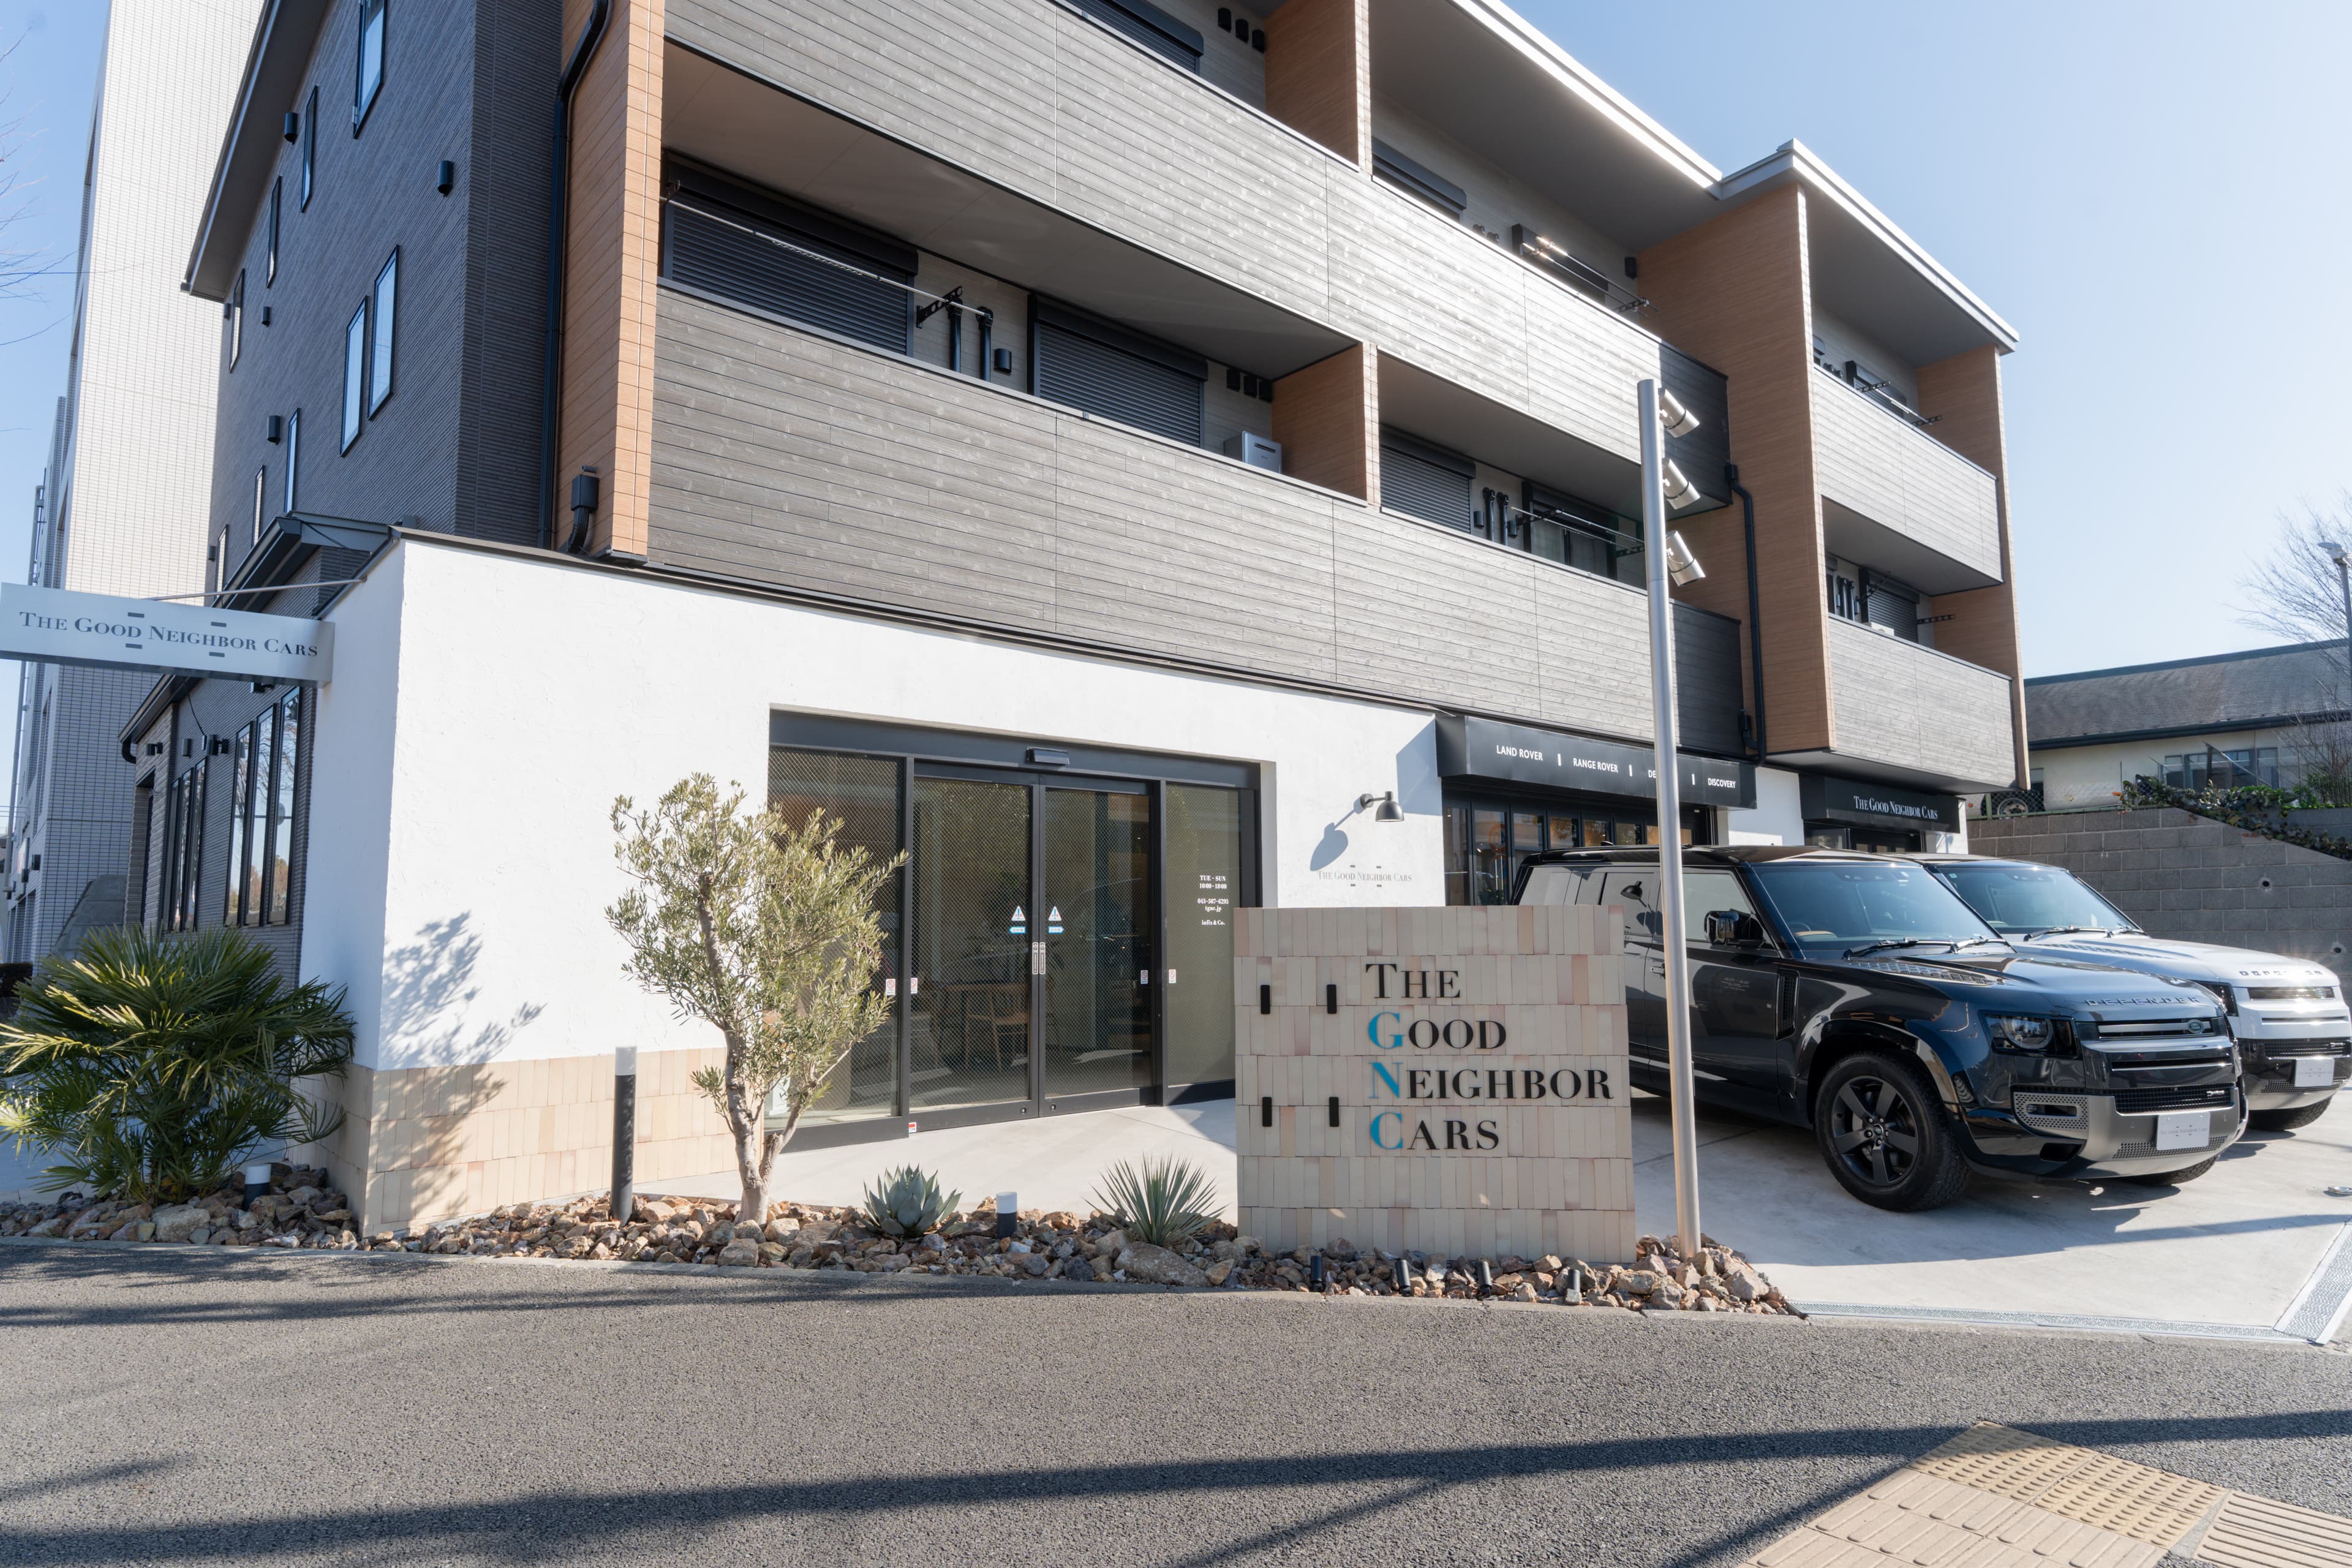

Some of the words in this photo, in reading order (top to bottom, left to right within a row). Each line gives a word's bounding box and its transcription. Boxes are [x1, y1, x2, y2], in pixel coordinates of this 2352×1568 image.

[19, 611, 67, 631] THE
[74, 617, 142, 638] GOOD
[148, 625, 256, 651] NEIGHBOR
[264, 638, 318, 657] CARS
[1496, 745, 1517, 757] LAND
[1519, 748, 1543, 761] ROVER
[1573, 758, 1596, 769] RANGE
[1597, 761, 1619, 773] ROVER
[1707, 777, 1736, 788] DISCOVERY
[1853, 795, 1868, 810] THE
[1869, 797, 1889, 813] GOOD
[1890, 801, 1921, 818] NEIGHBOR
[1921, 805, 1939, 820] CARS
[1317, 870, 1333, 880] THE
[1334, 872, 1355, 880] GOOD
[1357, 872, 1392, 881] NEIGHBOR
[1393, 872, 1412, 882] CARS
[1365, 963, 1460, 998] THE
[2084, 996, 2201, 1006] DEFENDER
[1368, 1011, 1507, 1049] GOOD
[1367, 1061, 1615, 1099] NEIGHBOR
[1370, 1112, 1500, 1150] CARS
